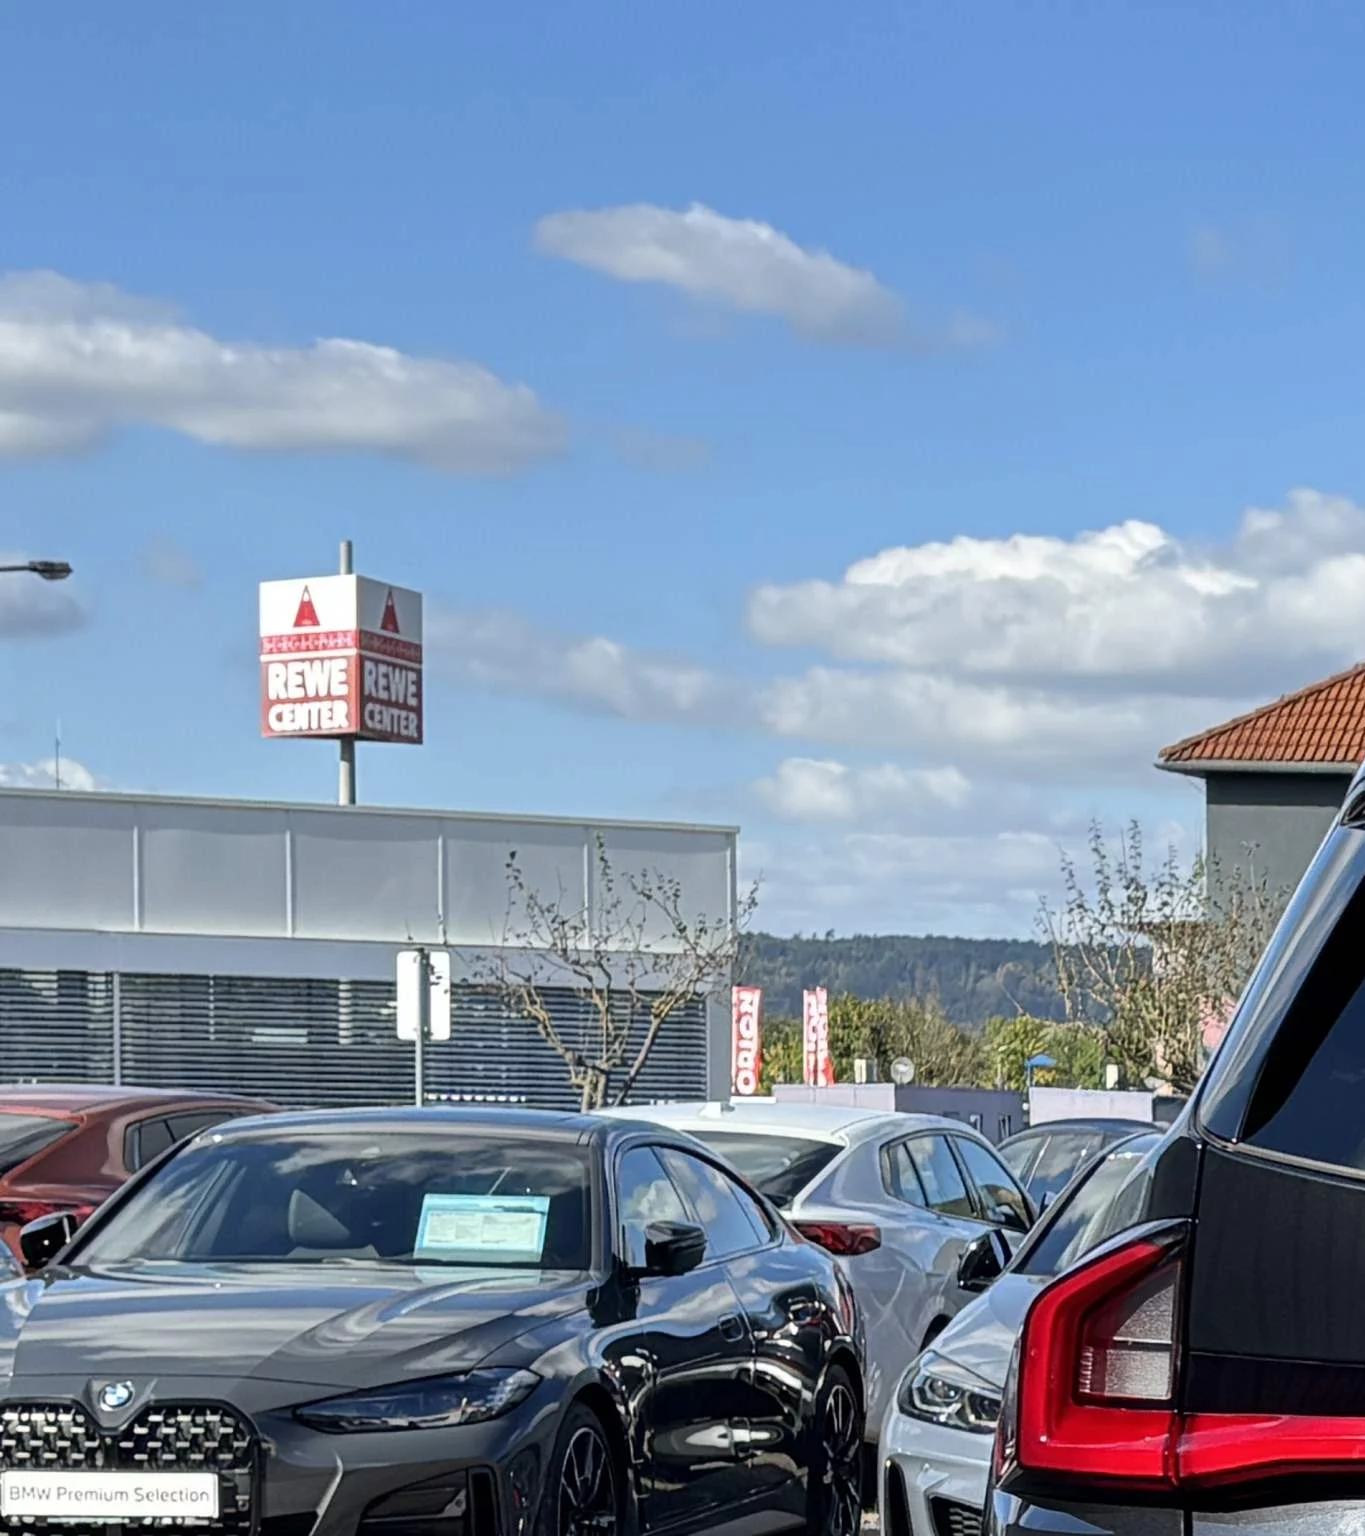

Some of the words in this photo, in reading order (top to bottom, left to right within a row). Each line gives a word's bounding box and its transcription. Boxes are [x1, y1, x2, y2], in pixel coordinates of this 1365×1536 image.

[268, 658, 349, 700] REWE
[364, 660, 418, 706] REWE
[268, 700, 349, 731] CENTER
[364, 702, 418, 738] CENTER
[9, 1486, 51, 1501] BMW
[57, 1486, 129, 1502] Premium
[134, 1487, 209, 1502] Selection
